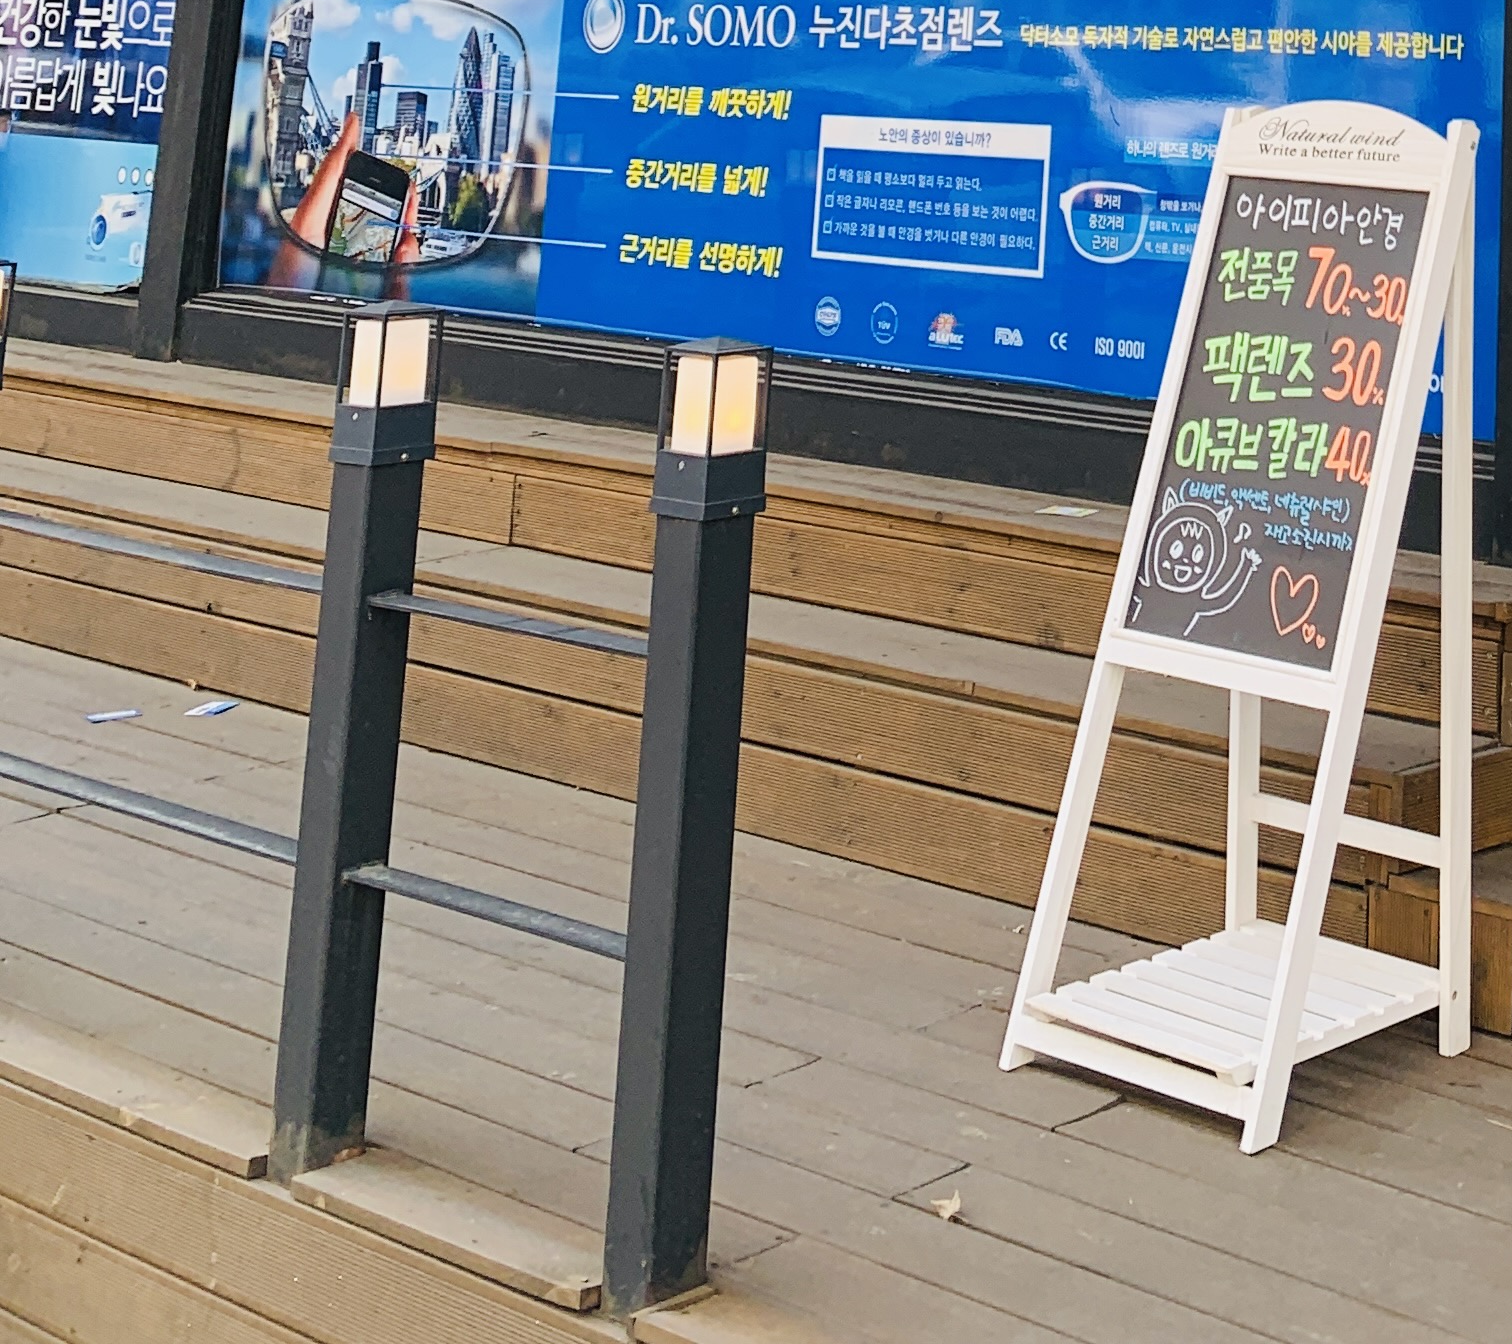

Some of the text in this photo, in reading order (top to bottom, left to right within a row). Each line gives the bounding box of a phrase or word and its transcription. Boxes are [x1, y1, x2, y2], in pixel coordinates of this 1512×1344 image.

[634, 4, 1465, 61] Dr. SOMO 누진다초점렌즈 닥터소모 독자적 기술로 자연스럽고 편안한 시야를 제공합니다
[91, 60, 167, 118] 빛나요
[632, 83, 793, 121] 원거리를 깨끗하게!
[878, 127, 992, 149] 노안의 증상이 있습니까?
[1127, 140, 1189, 159] 하나의 렌즈로
[1259, 116, 1407, 148] Natural wind
[1258, 142, 1402, 164] Write a better future
[625, 157, 769, 198] 중간거리를 넓게!
[1093, 193, 1122, 210] 원거리
[1088, 213, 1125, 231] 중간거리
[1235, 192, 1405, 252] 아이피아안경
[619, 234, 784, 279] 근거리를 선명하게!
[1092, 235, 1120, 252] 근거리
[1217, 245, 1299, 307] 전품목
[994, 326, 1145, 359] FDA CE ISO 9001
[1202, 330, 1386, 409] 팩렌즈 30%
[1174, 416, 1262, 476] 아큐브
